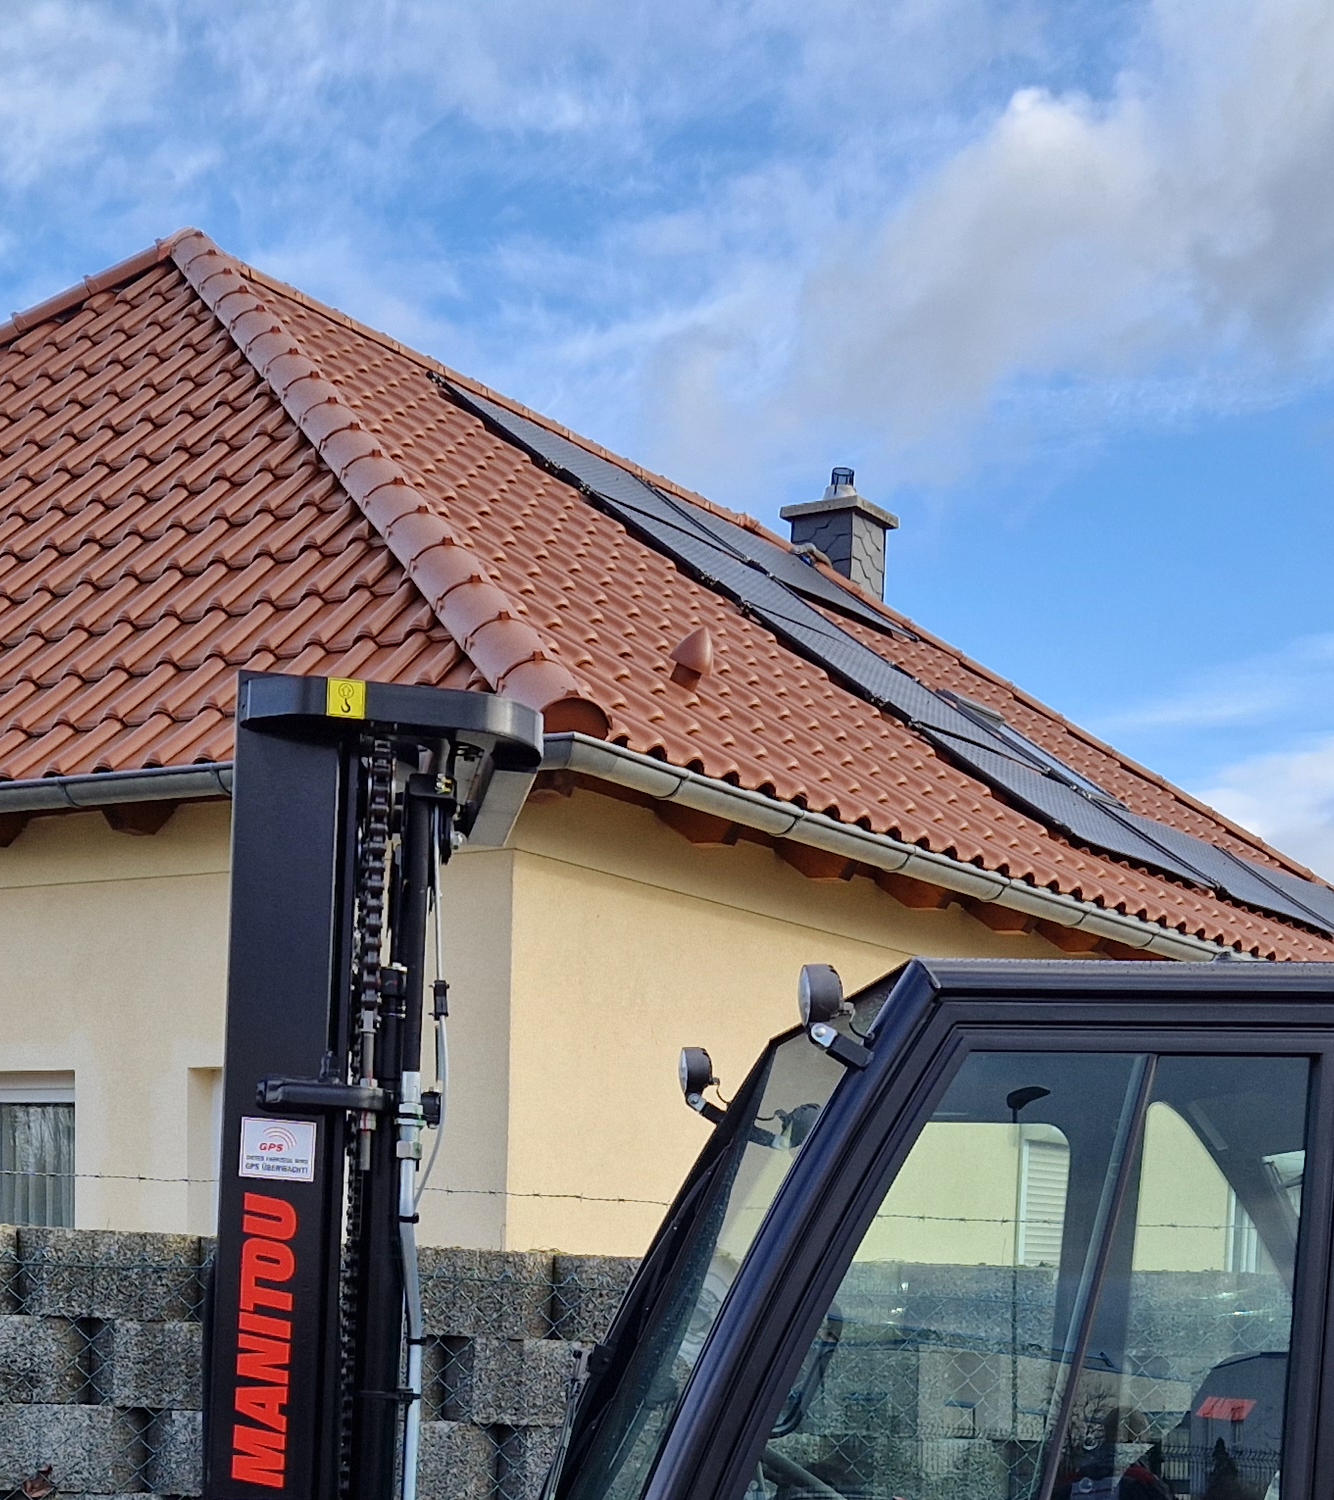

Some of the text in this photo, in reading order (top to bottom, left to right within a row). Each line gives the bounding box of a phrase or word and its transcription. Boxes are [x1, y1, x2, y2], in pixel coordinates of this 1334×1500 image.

[259, 1142, 284, 1152] GPS
[245, 1162, 260, 1171] GPS
[231, 1192, 298, 1488] MANITOU
